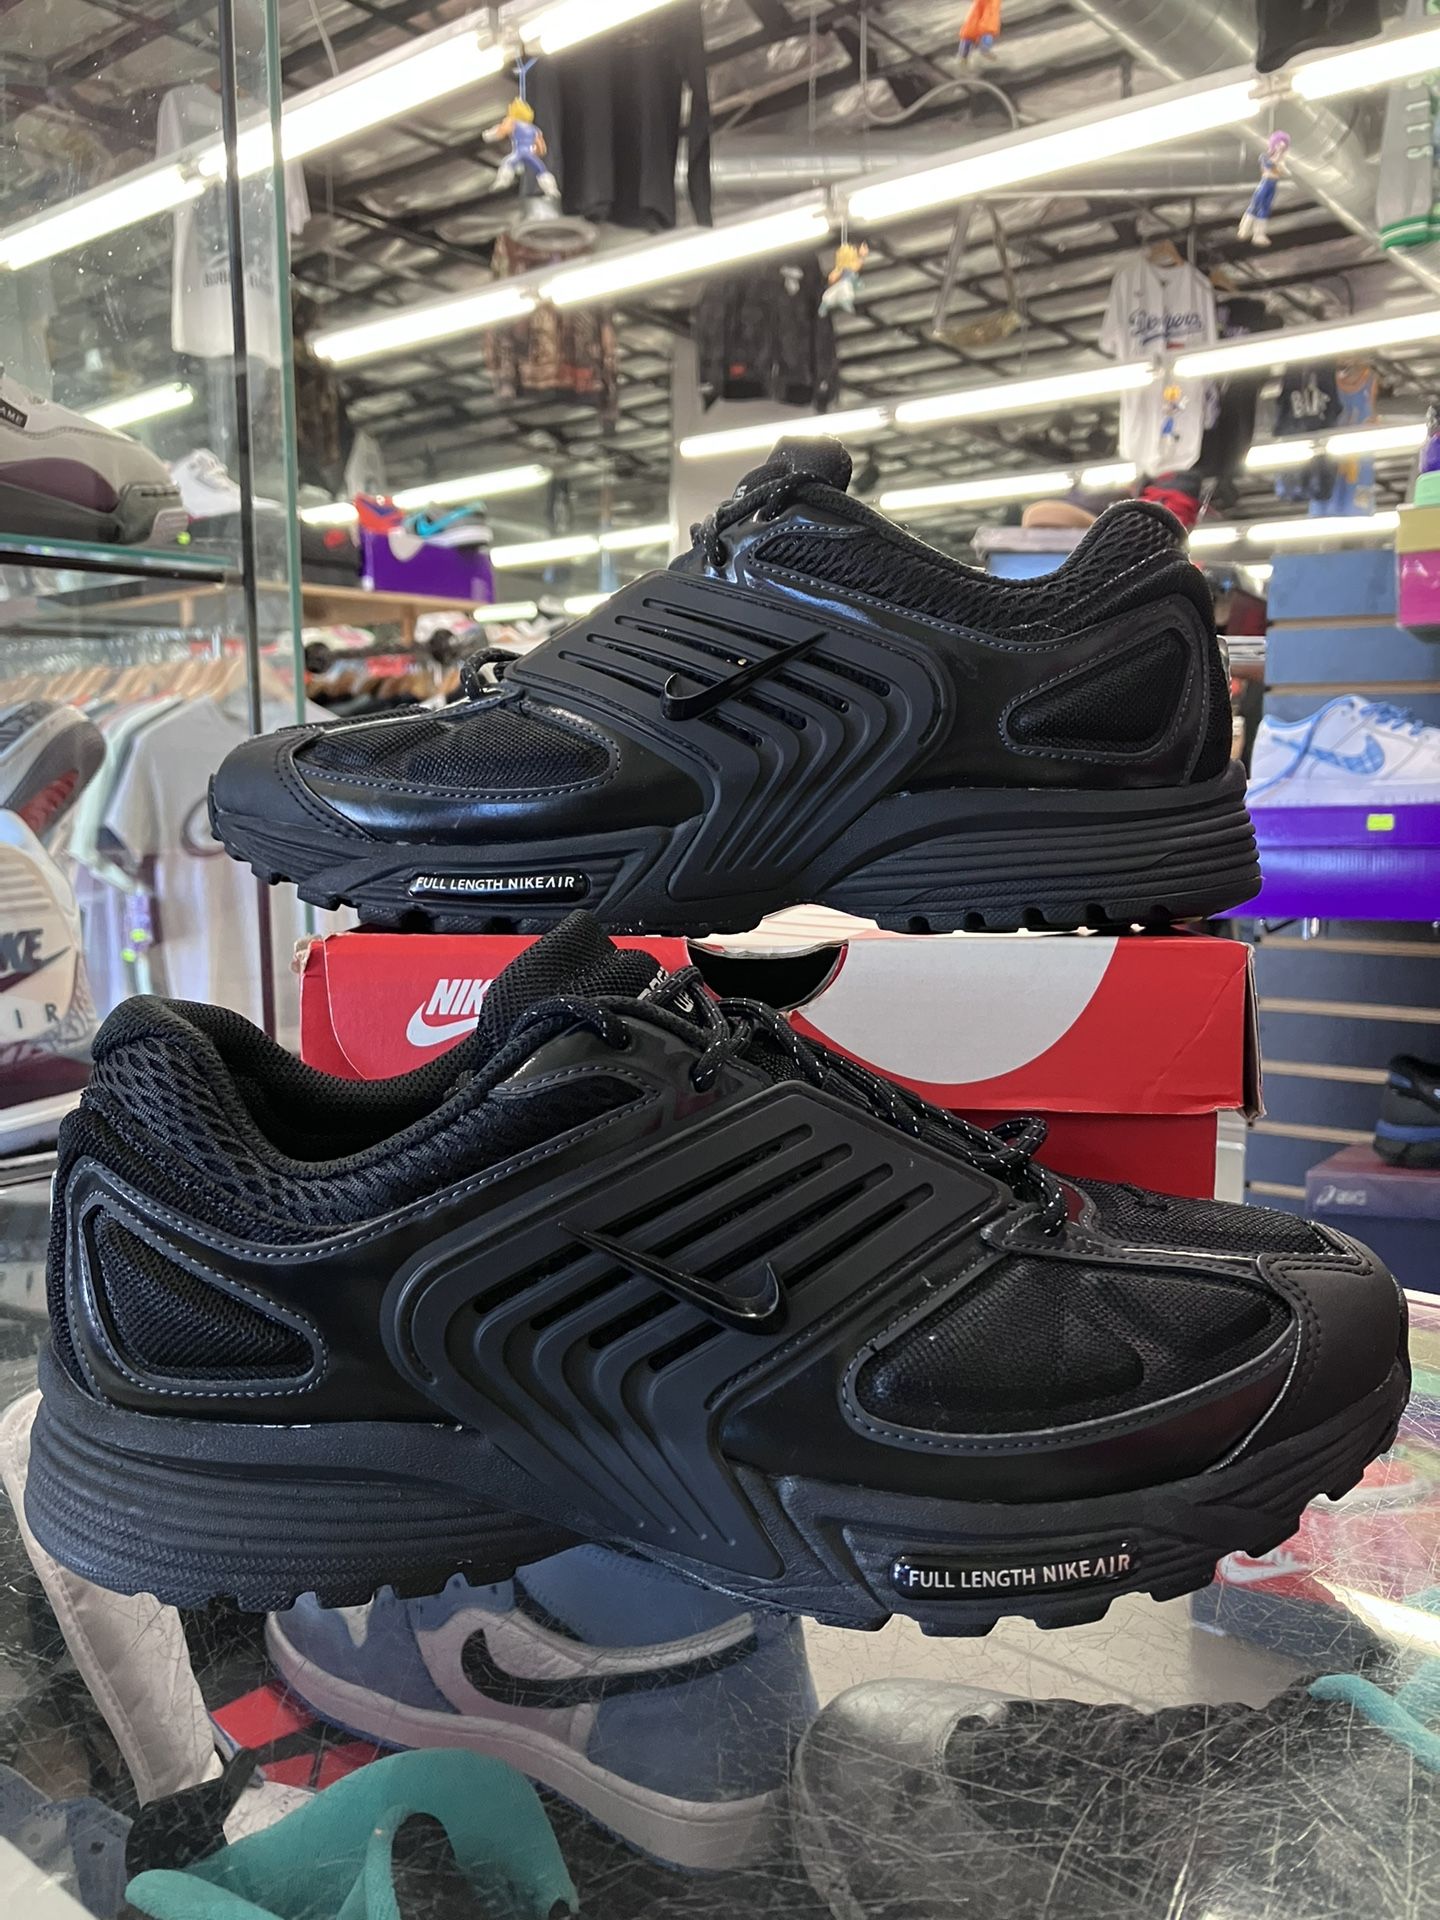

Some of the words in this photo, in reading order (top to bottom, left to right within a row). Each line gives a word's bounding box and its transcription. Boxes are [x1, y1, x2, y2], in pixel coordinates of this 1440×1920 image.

[416, 877, 446, 890] FULL
[450, 879, 503, 891] LENGTH
[425, 979, 494, 1015] NIK
[909, 1570, 955, 1588] FULL
[961, 1568, 1036, 1587] LENGTH
